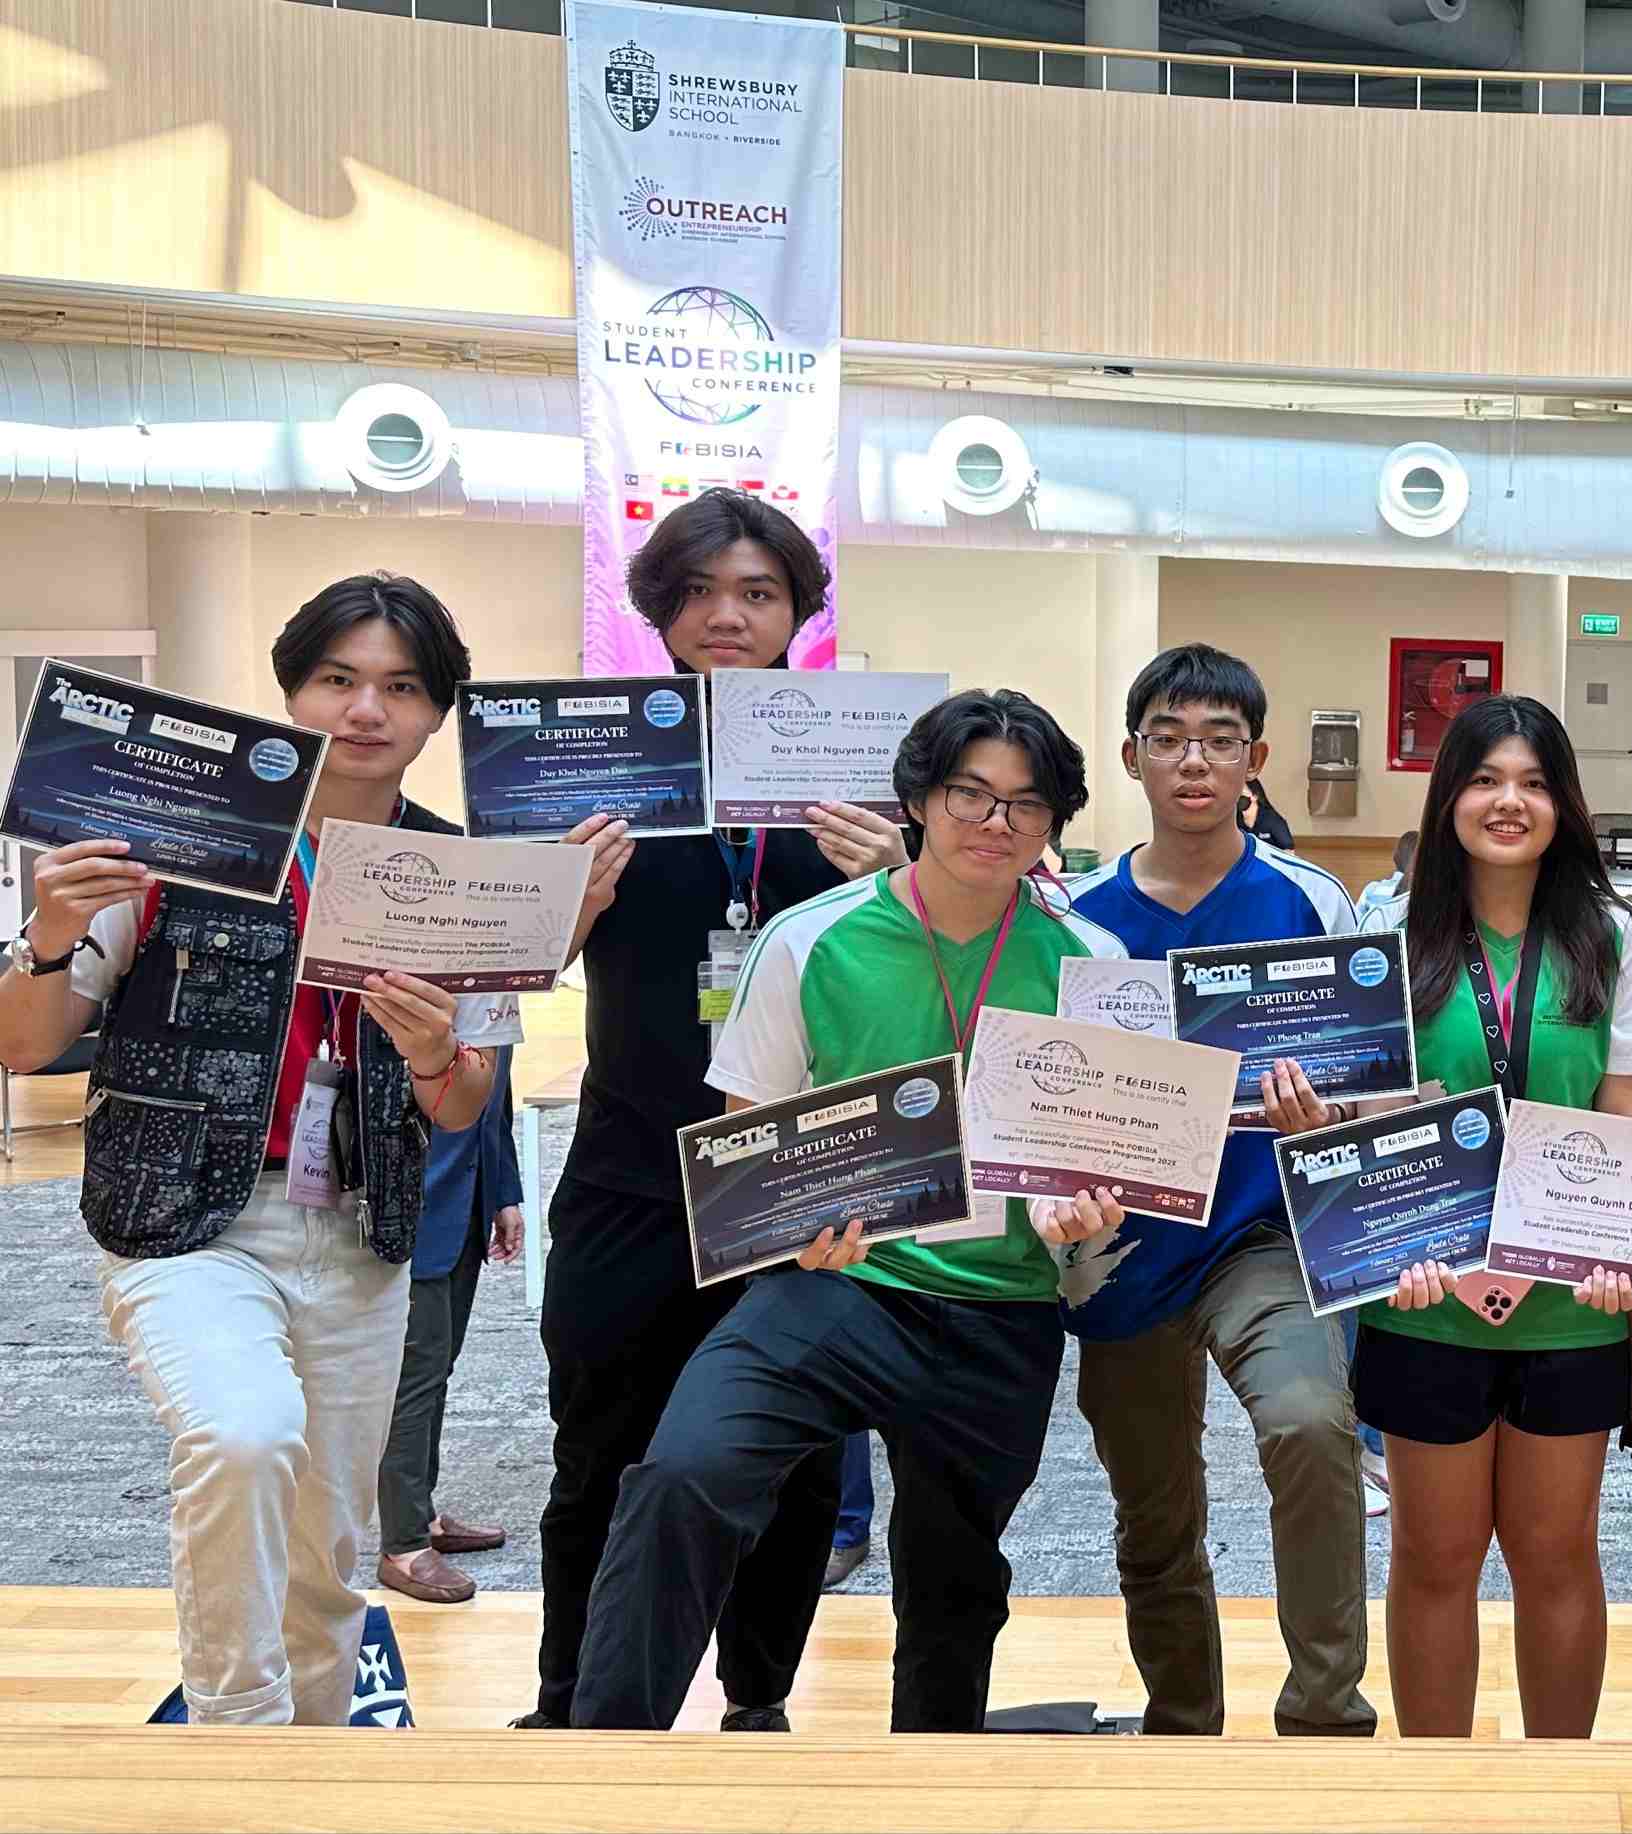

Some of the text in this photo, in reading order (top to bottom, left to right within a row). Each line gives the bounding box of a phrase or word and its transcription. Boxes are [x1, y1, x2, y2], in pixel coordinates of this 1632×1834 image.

[669, 73, 799, 96] SHREWSBURY
[669, 89, 802, 112] INTERNATIONAL
[669, 107, 739, 125] SCHOOL
[733, 135, 781, 145] RIVERSIDE
[647, 198, 788, 225] OUTREACH
[603, 321, 687, 338] STUDENT
[605, 340, 816, 374] LEADERSHIP
[692, 378, 816, 394] CONFERENCE
[55, 677, 72, 688] The
[49, 686, 134, 722] ARCTIC
[468, 693, 483, 702] The
[469, 698, 542, 716] ARCTIC
[752, 710, 832, 719] LEADERSHIP
[536, 726, 628, 741] CERTIFICATE
[114, 740, 223, 778] CERTIFICATE
[772, 744, 792, 756] Duy
[824, 746, 865, 755] Nguyen
[868, 747, 889, 755] Dao
[146, 764, 195, 781] COMPLETION
[109, 786, 200, 816] Luong Nghi Nguyen
[363, 869, 457, 888] LEADERSHIP
[386, 910, 507, 930] Luong Nghi Nguyen
[1182, 962, 1195, 970] The
[1182, 963, 1252, 985] ARCTIC
[1246, 987, 1336, 1008] CERTIFICATE
[1016, 1058, 1104, 1081] LEADERSHIP
[1030, 1101, 1159, 1131] Nam Thiet Hung Phan
[695, 1136, 711, 1145] The
[695, 1122, 779, 1160] ARCTIC
[772, 1125, 877, 1164] CERTIFICATE
[993, 1134, 1156, 1163] Student Leadership Conference Programme
[1111, 1141, 1124, 1149] The
[1290, 1149, 1303, 1158] The
[1292, 1143, 1360, 1175] ARCTIC
[1542, 1150, 1623, 1169] LEADERSHIP
[304, 1164, 330, 1179] Kevin
[1358, 1156, 1444, 1187] CERTIFICATE
[780, 1185, 802, 1198] Nam
[1546, 1188, 1587, 1204] Nguyen
[1590, 1195, 1625, 1211] Quynh
[1592, 1231, 1630, 1242] Conference
